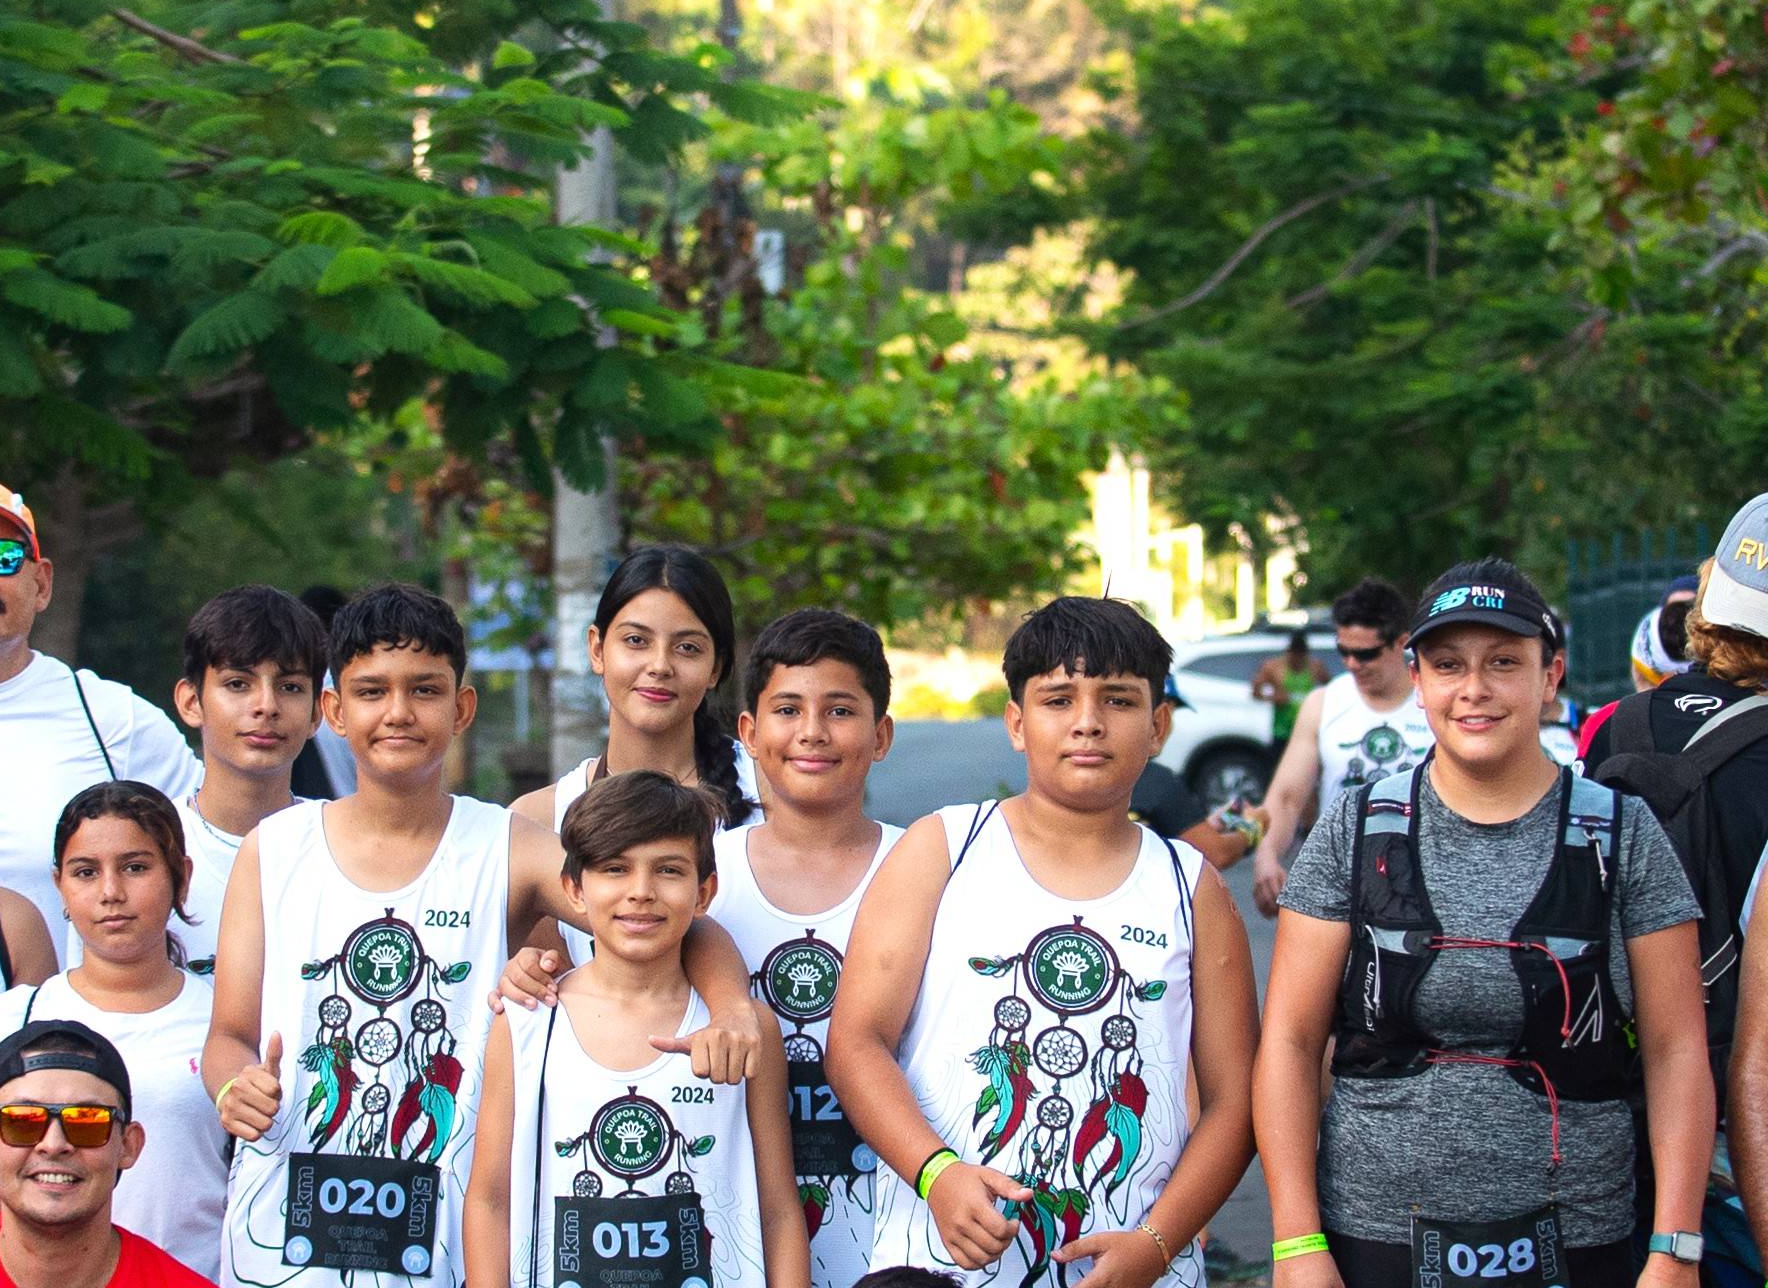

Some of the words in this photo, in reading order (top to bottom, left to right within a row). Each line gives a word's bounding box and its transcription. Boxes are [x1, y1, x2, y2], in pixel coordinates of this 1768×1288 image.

[1471, 585, 1505, 599] RUN
[1472, 595, 1504, 610] CRI
[424, 908, 471, 928] 2024
[358, 932, 392, 958] QUEPOA
[1042, 938, 1079, 963] QUEPOA
[1120, 923, 1169, 951] 2024
[777, 950, 812, 976] QUEPOA
[813, 952, 834, 977] TRAIL
[785, 993, 826, 1010] RUNNING
[1048, 983, 1092, 1002] RUNNING
[671, 1085, 715, 1104] 2024
[787, 1084, 844, 1123] 12
[604, 1109, 636, 1135] QUEPOA
[637, 1110, 659, 1132] TRAIL
[613, 1149, 653, 1166] RUNNING
[292, 1165, 315, 1229] 5km
[318, 1176, 407, 1220] 020
[408, 1175, 434, 1238] 5km
[558, 1208, 580, 1274] 5km
[591, 1219, 671, 1260] 013
[678, 1207, 701, 1271] 5km
[1535, 1217, 1559, 1281] 5km
[1447, 1236, 1536, 1279] 028
